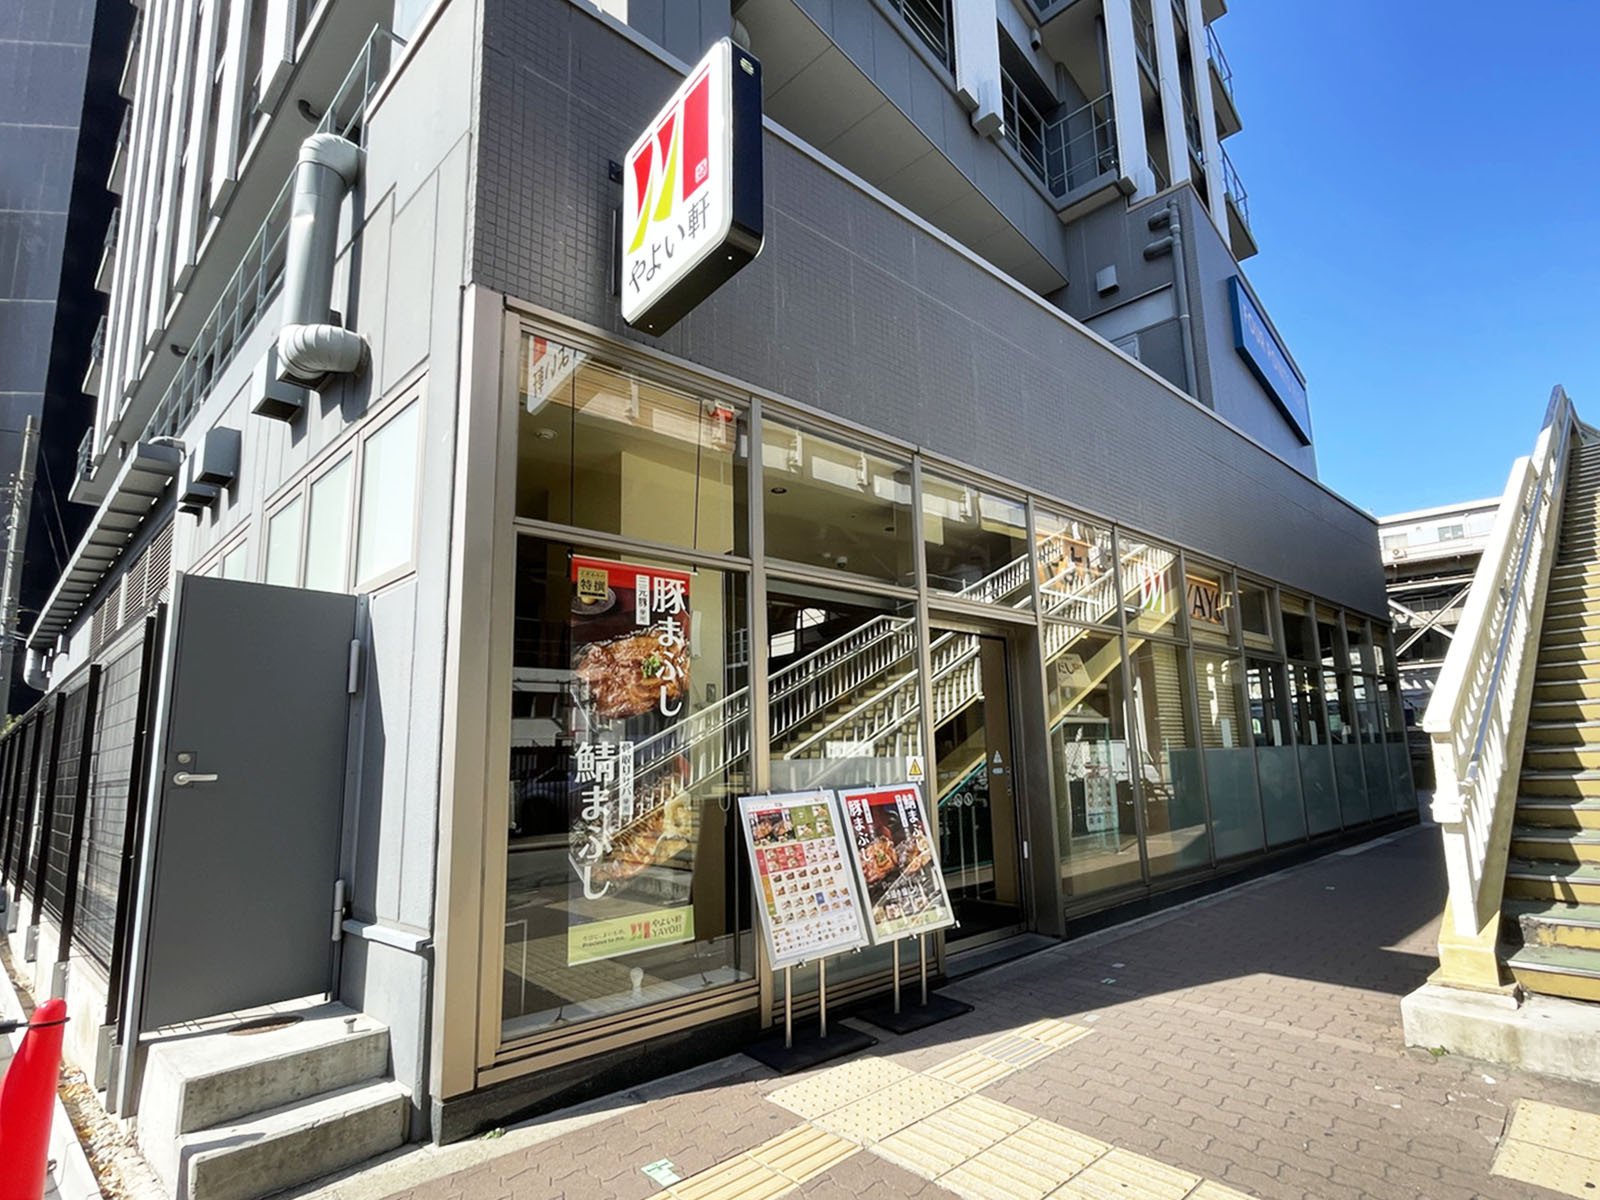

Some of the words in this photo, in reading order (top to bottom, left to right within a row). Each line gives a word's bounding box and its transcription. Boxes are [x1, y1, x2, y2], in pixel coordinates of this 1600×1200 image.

[628, 190, 710, 293] やよい軒
[651, 576, 688, 717] 豚まぶし
[574, 741, 616, 900] 鯖まぶし
